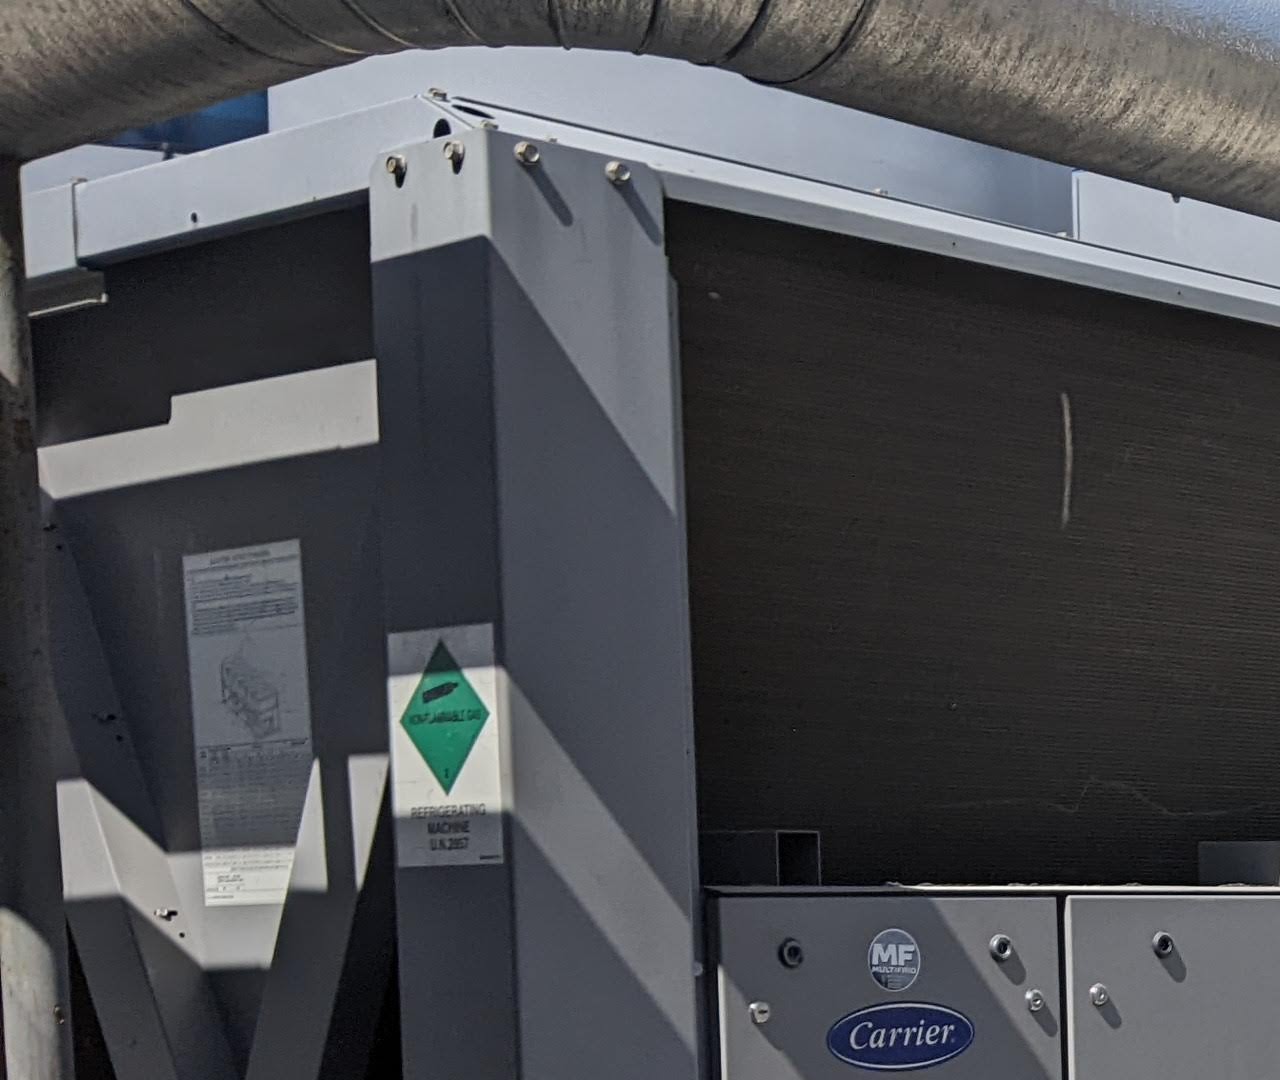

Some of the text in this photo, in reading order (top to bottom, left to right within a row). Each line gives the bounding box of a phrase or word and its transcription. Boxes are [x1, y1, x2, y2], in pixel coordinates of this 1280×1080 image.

[410, 803, 486, 818] REFRIGERATING
[427, 821, 470, 834] MACHINE
[872, 943, 915, 966] MF
[850, 1019, 955, 1050] Carrier
